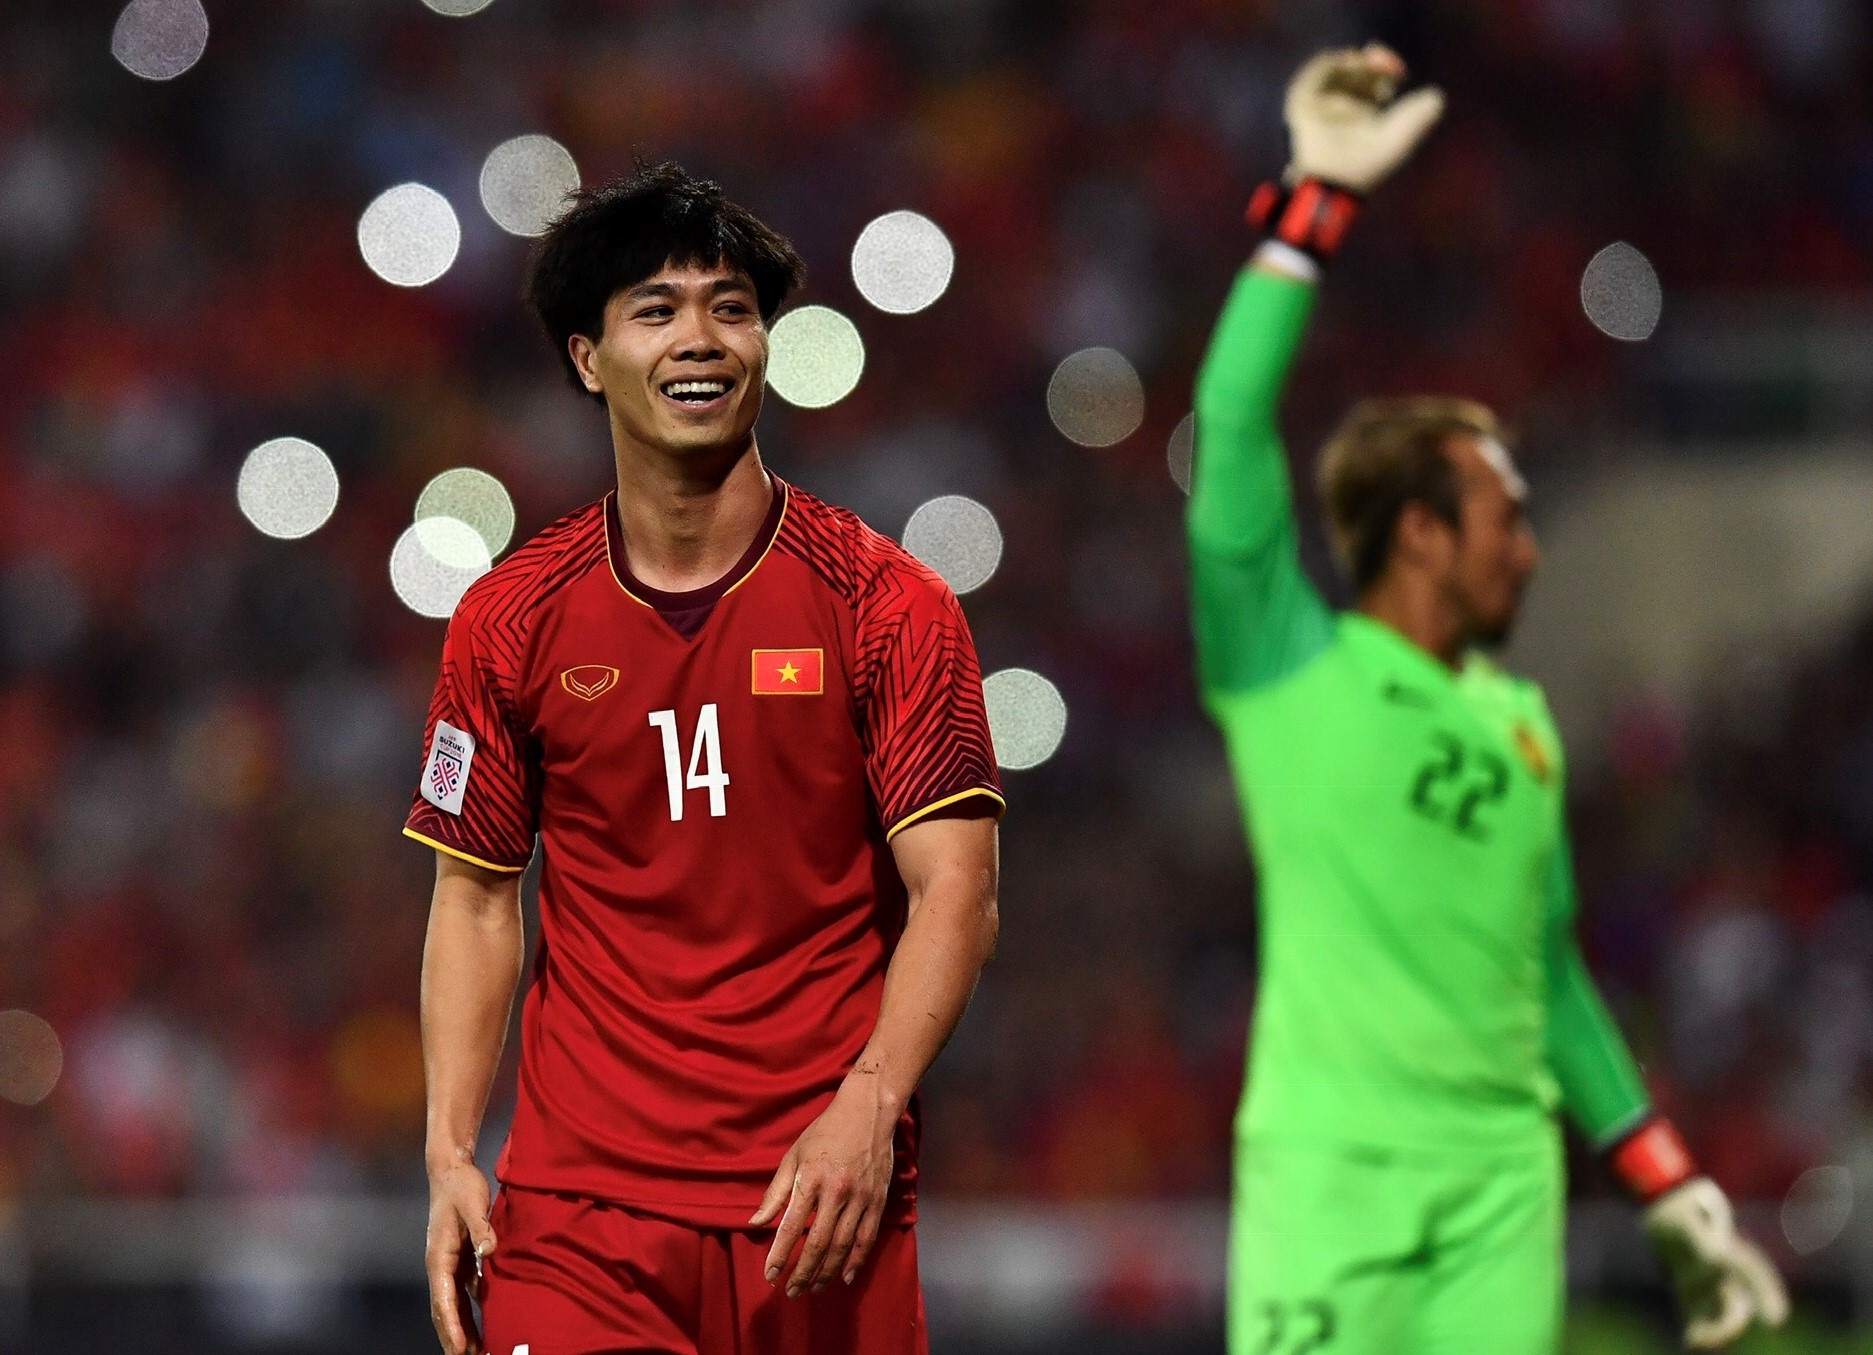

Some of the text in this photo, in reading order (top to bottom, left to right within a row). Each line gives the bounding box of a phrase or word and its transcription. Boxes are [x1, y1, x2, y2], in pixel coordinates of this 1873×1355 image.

[439, 736, 465, 753] SUZUKI
[648, 703, 730, 821] 14
[1410, 730, 1510, 842] 22
